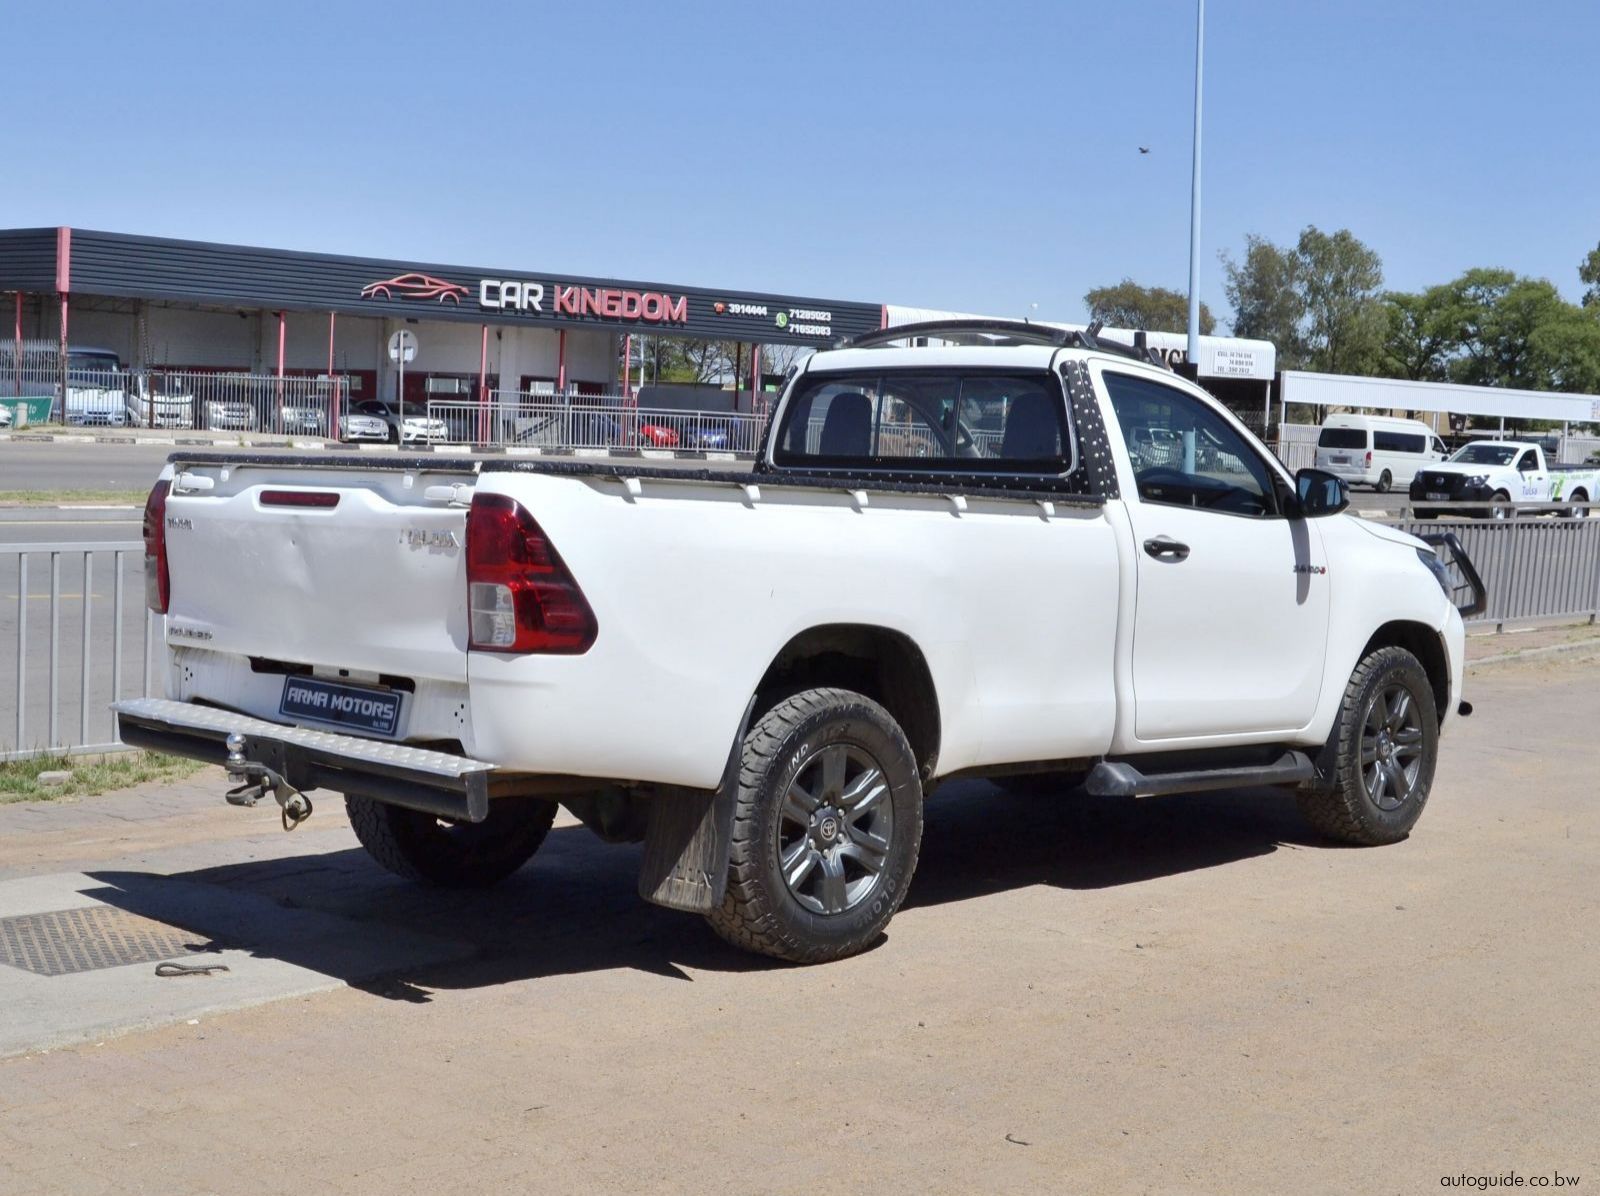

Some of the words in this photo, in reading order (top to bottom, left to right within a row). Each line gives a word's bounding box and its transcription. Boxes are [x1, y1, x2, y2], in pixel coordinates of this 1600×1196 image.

[480, 280, 544, 311] CAR
[554, 285, 688, 323] KINGDOM
[728, 303, 768, 316] 3914444
[287, 686, 329, 708] ARMA
[331, 694, 394, 720] MOTORS
